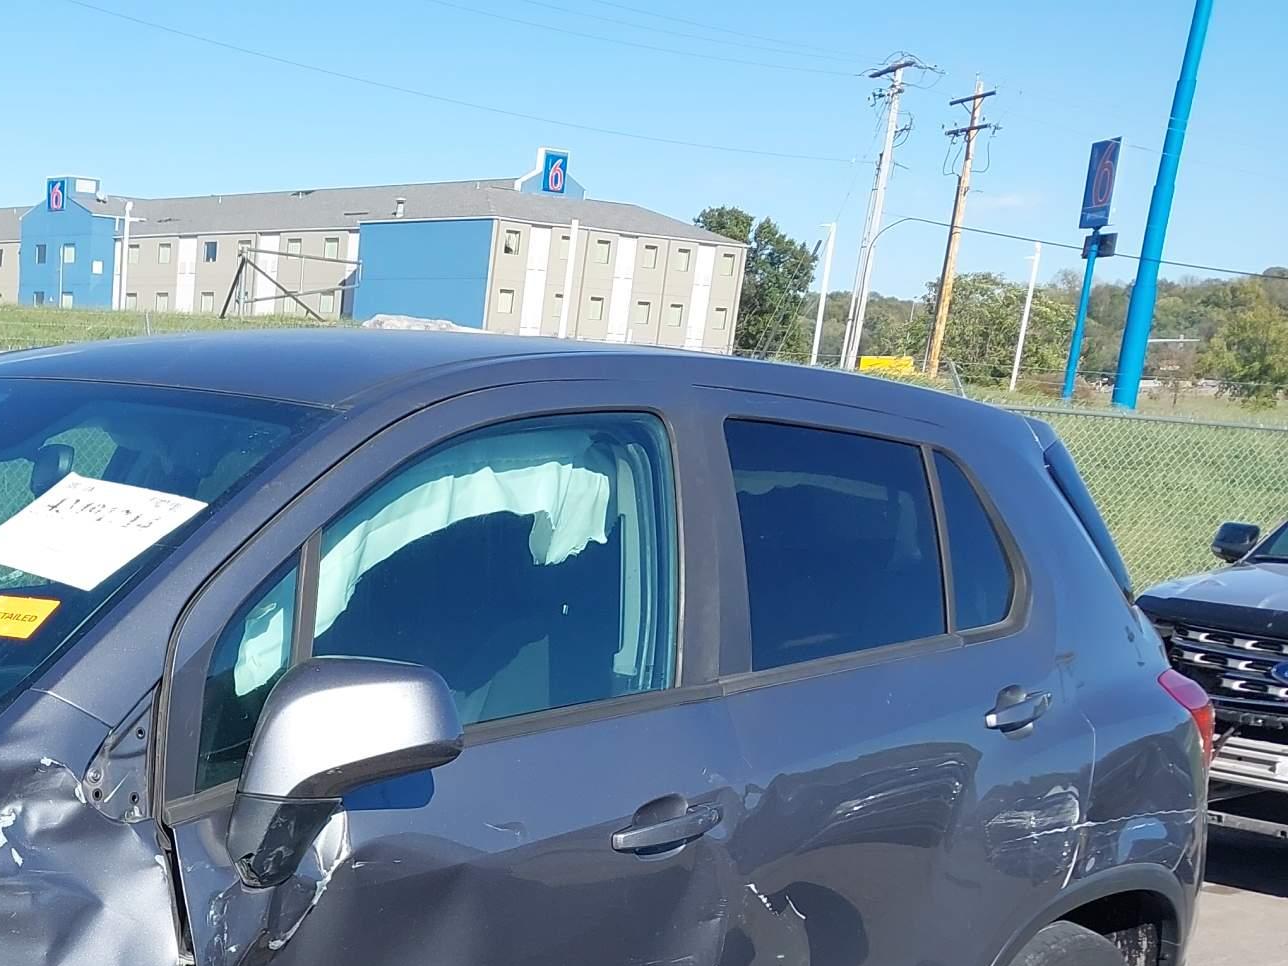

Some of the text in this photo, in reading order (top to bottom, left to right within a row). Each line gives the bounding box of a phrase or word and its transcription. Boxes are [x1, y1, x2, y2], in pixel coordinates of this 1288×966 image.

[549, 158, 564, 191] 6
[1093, 142, 1114, 207] 6
[51, 181, 63, 209] 6
